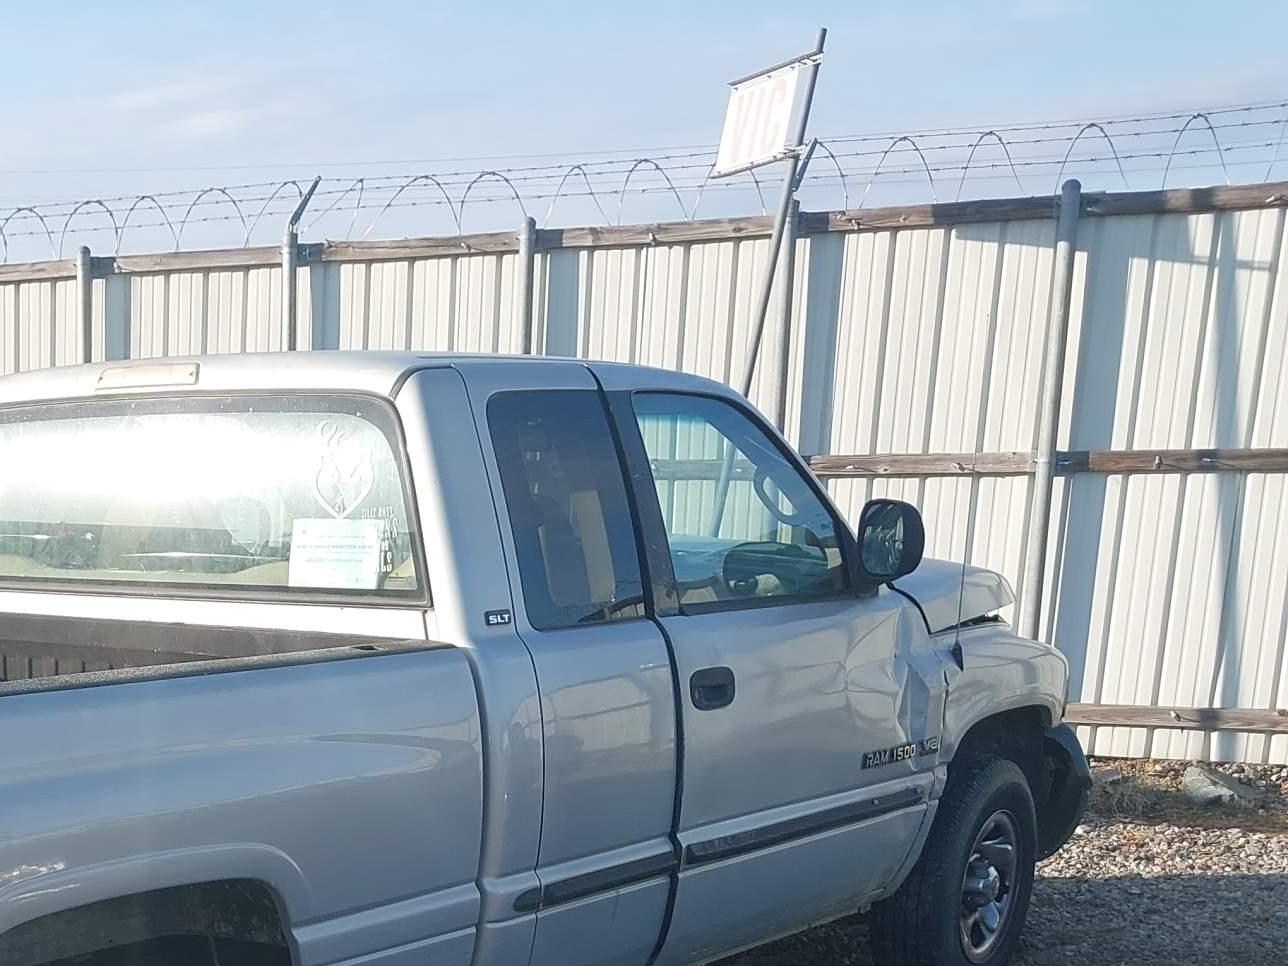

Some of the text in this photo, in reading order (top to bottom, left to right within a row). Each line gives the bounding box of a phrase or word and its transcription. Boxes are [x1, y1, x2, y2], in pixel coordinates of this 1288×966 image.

[488, 613, 510, 625] SLT
[866, 751, 890, 768] RAM
[893, 744, 916, 761] 1500
